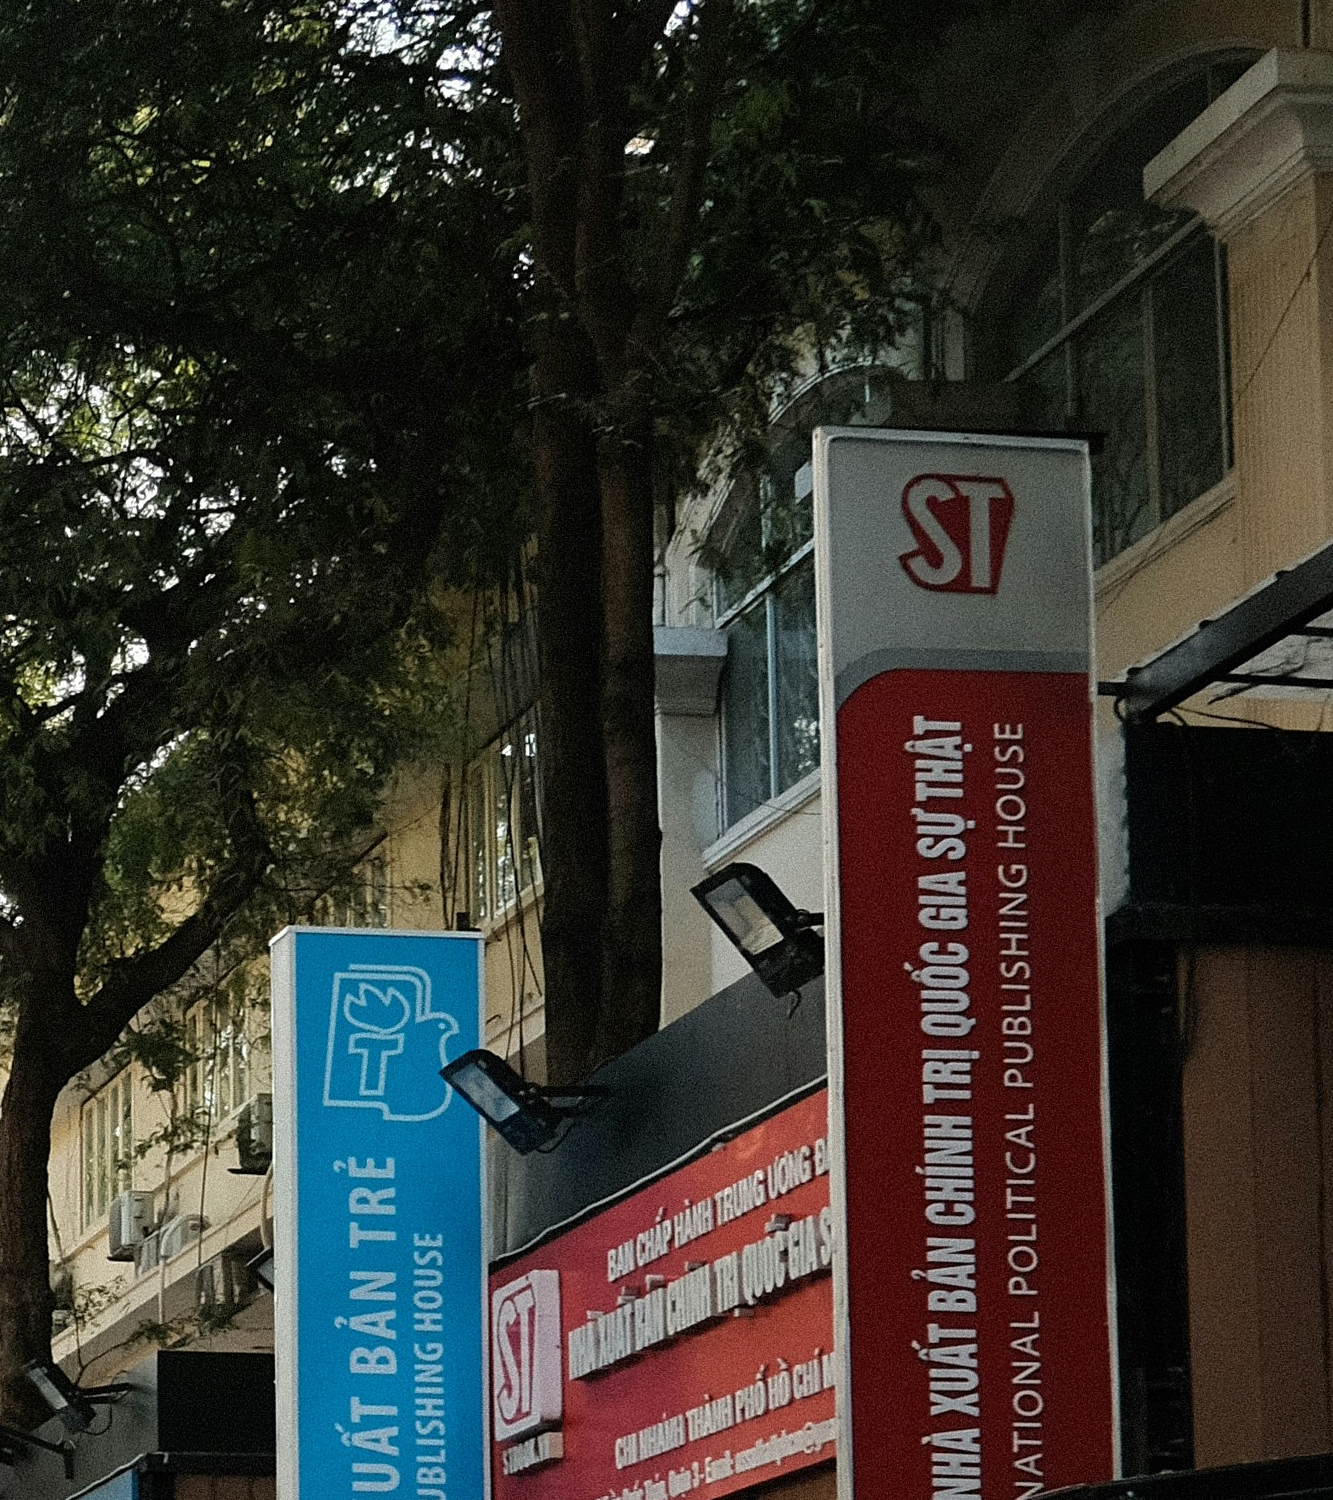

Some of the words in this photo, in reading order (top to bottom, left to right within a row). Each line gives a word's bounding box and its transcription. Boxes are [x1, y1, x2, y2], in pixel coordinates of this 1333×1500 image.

[899, 473, 1016, 595] ST
[904, 715, 973, 801] THẬT
[993, 722, 1027, 848] HOUSE
[910, 808, 976, 860] SỰ
[918, 871, 969, 930] GIA
[904, 942, 976, 1037] QUỐC
[998, 864, 1034, 1088] PUBLISHING
[922, 1049, 980, 1104] TRỊ
[333, 1156, 397, 1249] TRẺ
[715, 1169, 766, 1226] TRUNG
[915, 1115, 977, 1225] CHÍNH
[1004, 1102, 1039, 1295] POLITICAL
[413, 1233, 444, 1332] HOUSE
[911, 1237, 977, 1313] BẢN
[334, 1271, 398, 1375] BẢN
[911, 1323, 980, 1417] XUẤT
